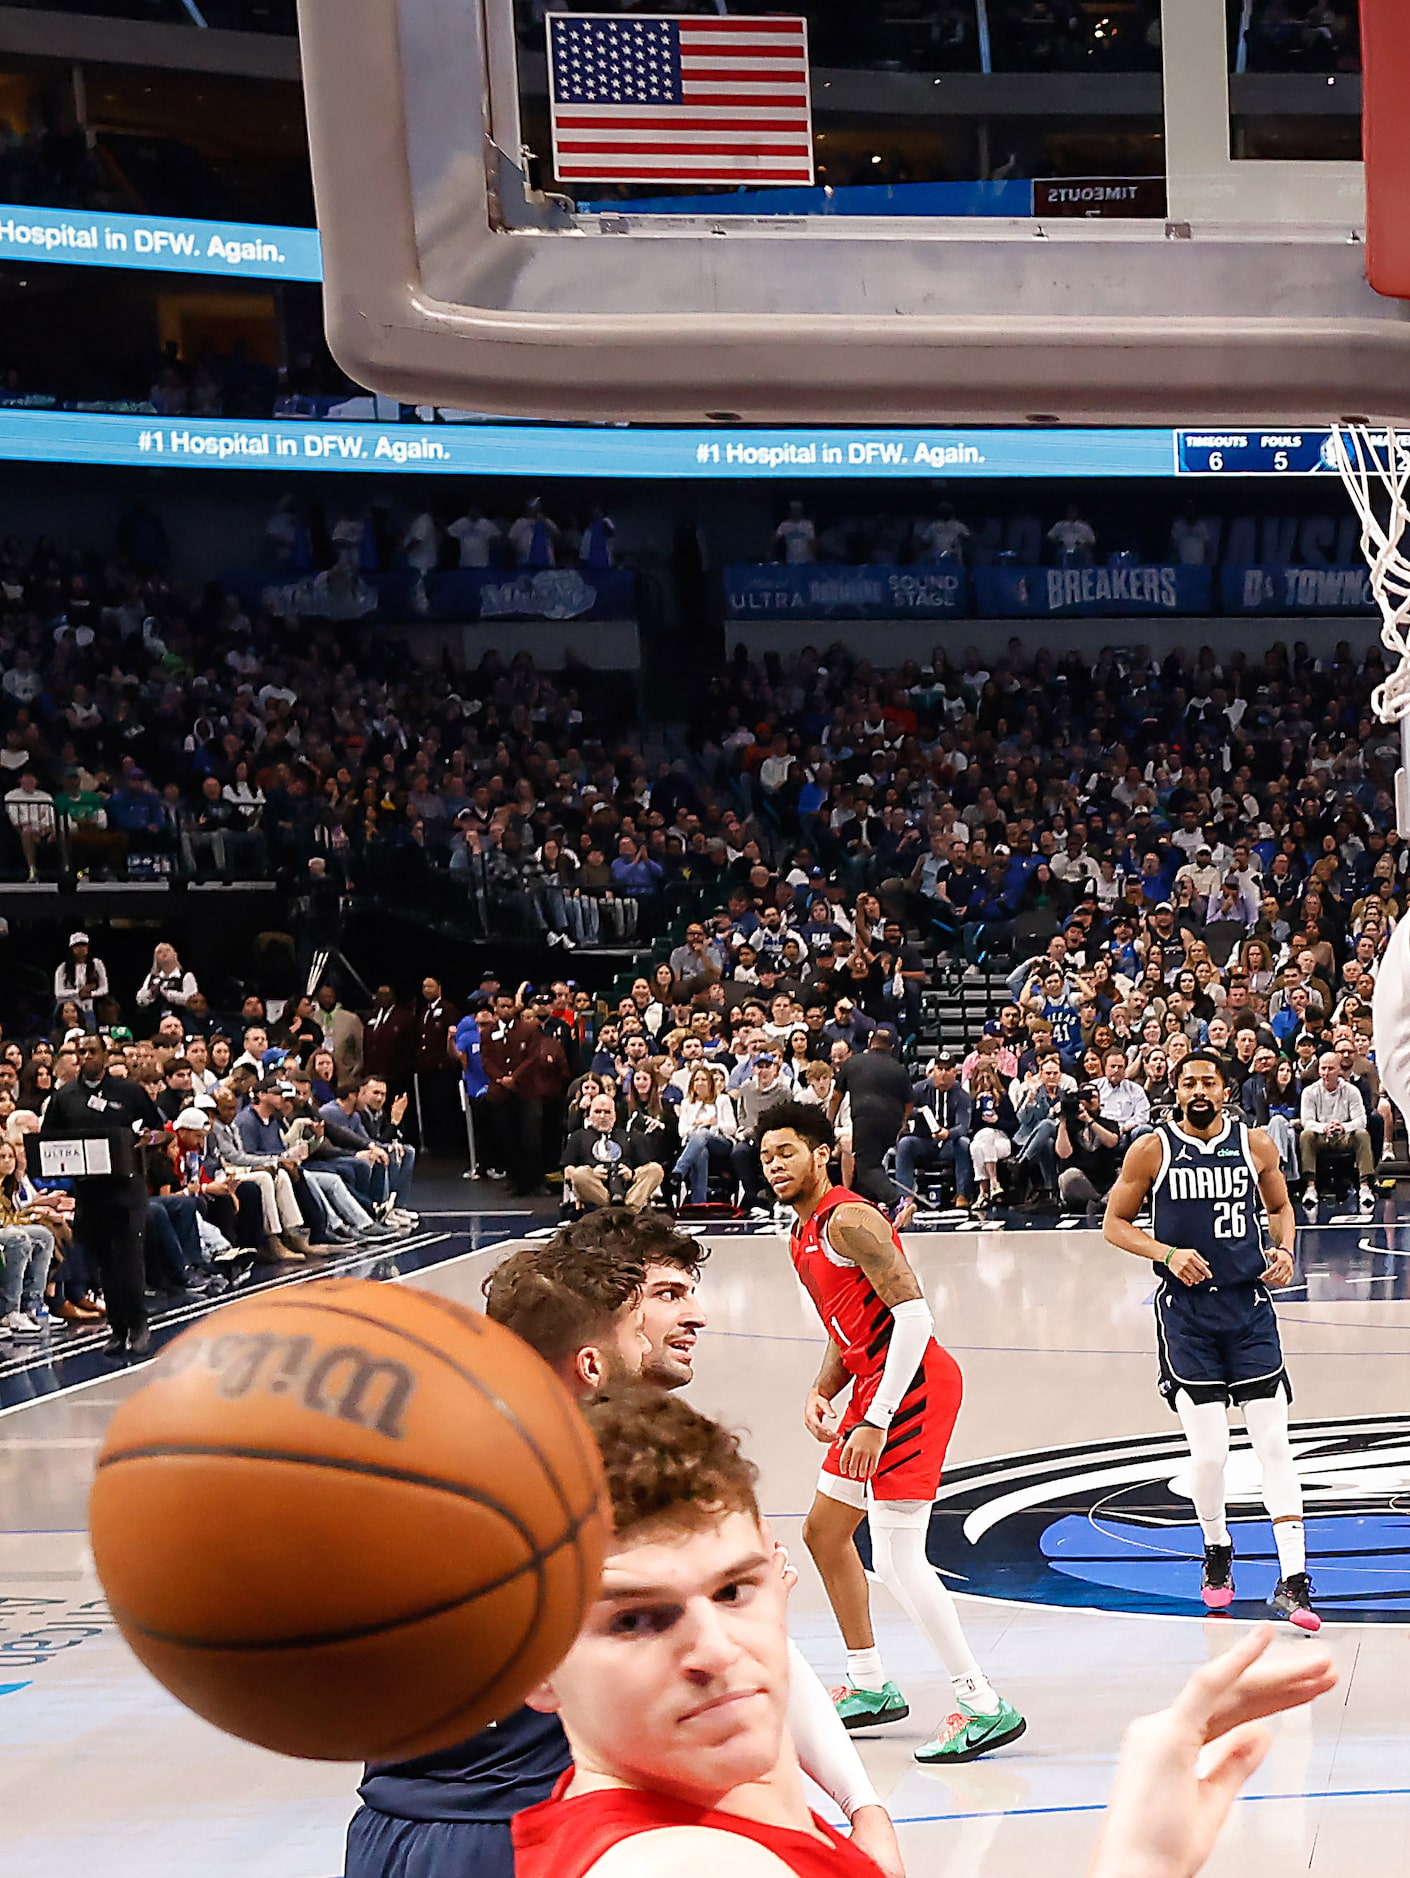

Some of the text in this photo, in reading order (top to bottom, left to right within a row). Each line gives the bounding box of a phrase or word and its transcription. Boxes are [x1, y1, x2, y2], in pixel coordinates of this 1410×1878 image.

[105, 228, 127, 251] in
[134, 230, 200, 257] DFW.
[207, 235, 285, 264] Again.
[138, 431, 451, 463] #1 Hospital in DFW. Again.
[696, 443, 986, 468] #1 Hospital in DFW. Again.
[1185, 435, 1302, 448] TIMEOUTS FOULS
[1208, 452, 1289, 471] 6 5
[1046, 567, 1177, 610] BREAKERS
[1053, 1023, 1070, 1042] 41
[1217, 1148, 1240, 1157] chime
[1169, 1166, 1248, 1200] MAVS
[1213, 1202, 1246, 1238] 26
